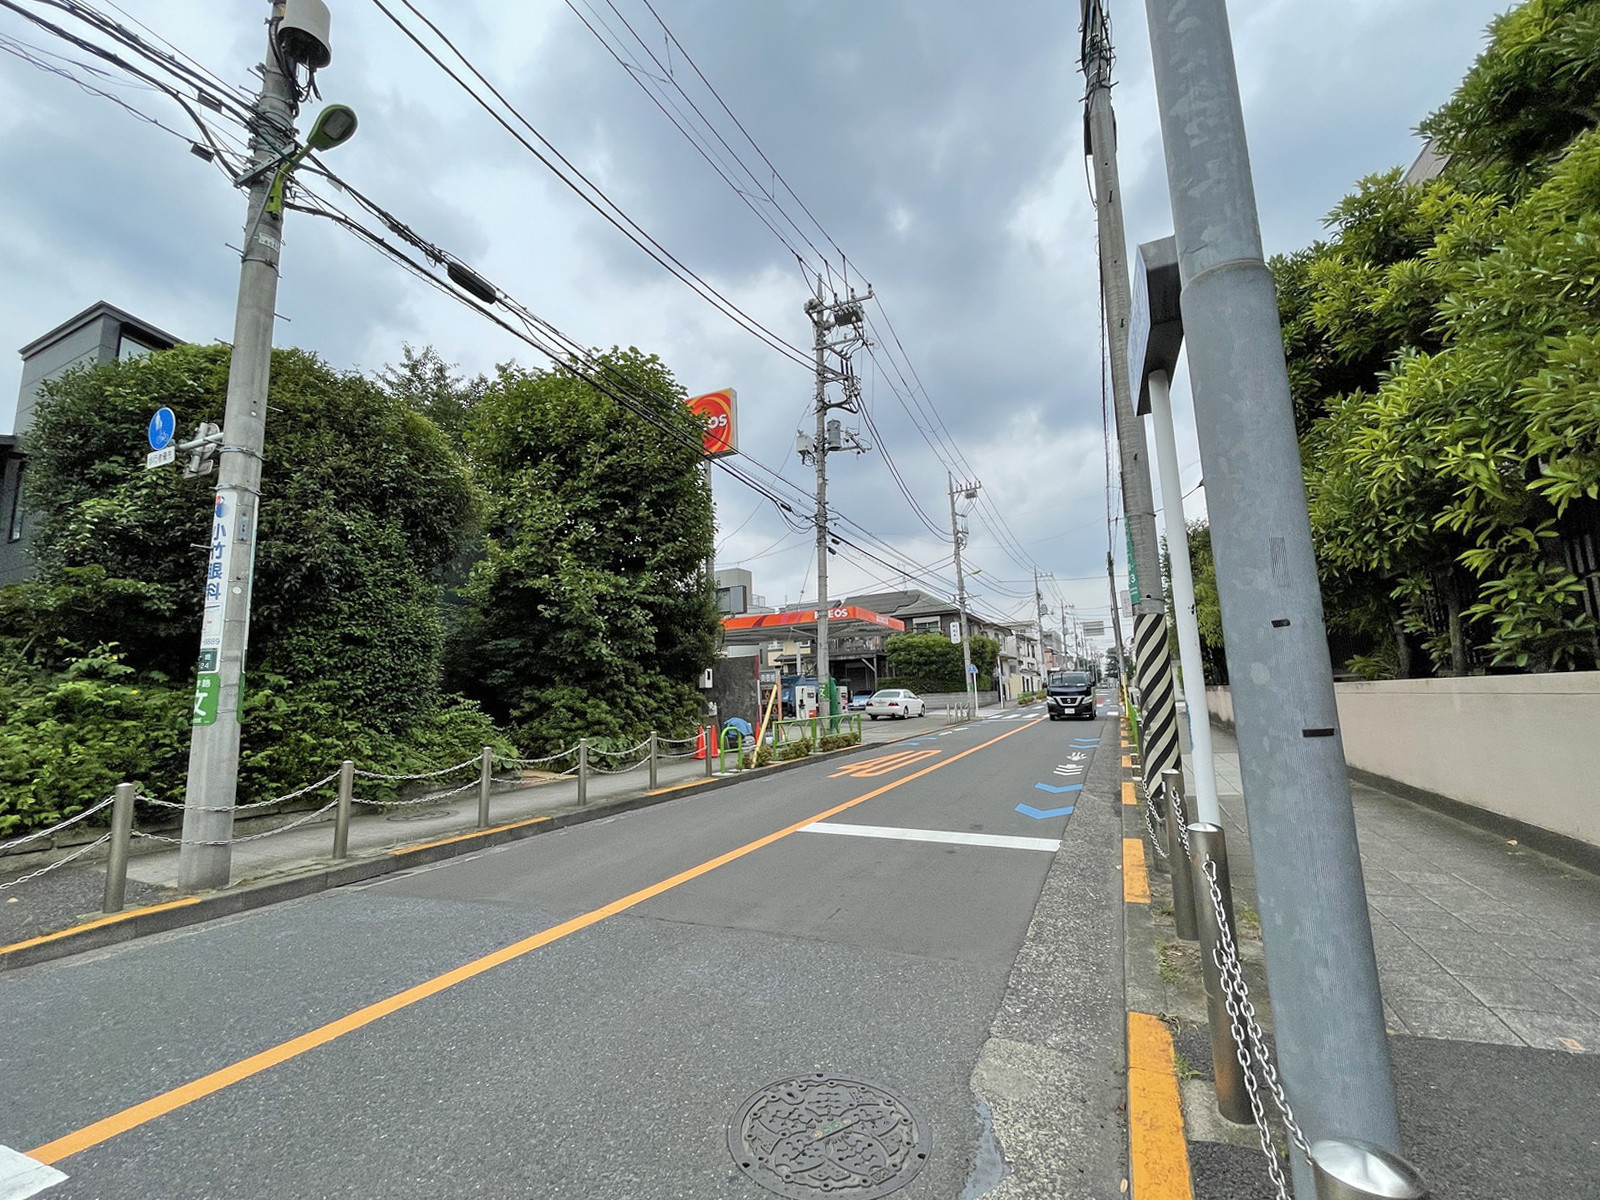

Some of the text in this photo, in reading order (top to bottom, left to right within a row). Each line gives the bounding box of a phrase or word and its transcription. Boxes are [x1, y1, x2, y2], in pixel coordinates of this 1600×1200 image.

[702, 413, 728, 429] OS
[207, 523, 226, 600] 小竹眼科
[814, 608, 848, 619] EEOS
